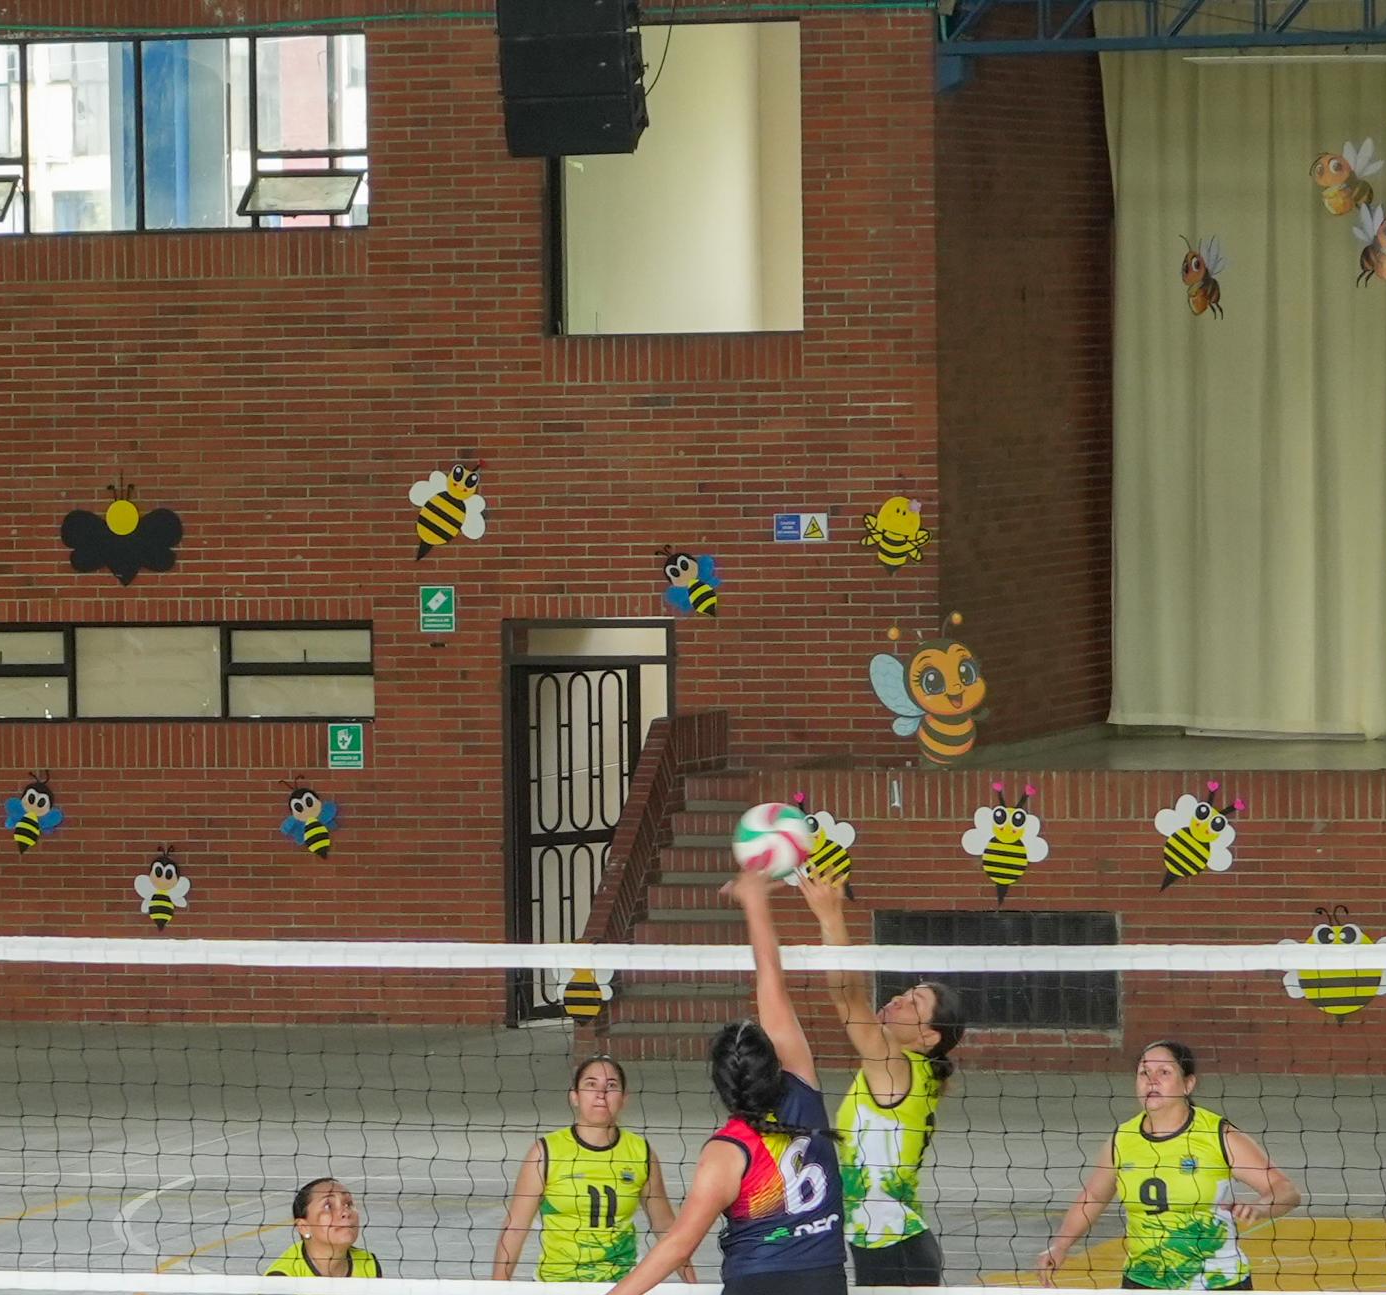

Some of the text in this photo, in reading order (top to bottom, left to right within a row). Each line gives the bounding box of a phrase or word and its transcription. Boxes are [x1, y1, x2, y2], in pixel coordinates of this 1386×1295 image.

[779, 1135, 828, 1215] 6
[1138, 1176, 1170, 1215] 9
[587, 1184, 618, 1229] 11
